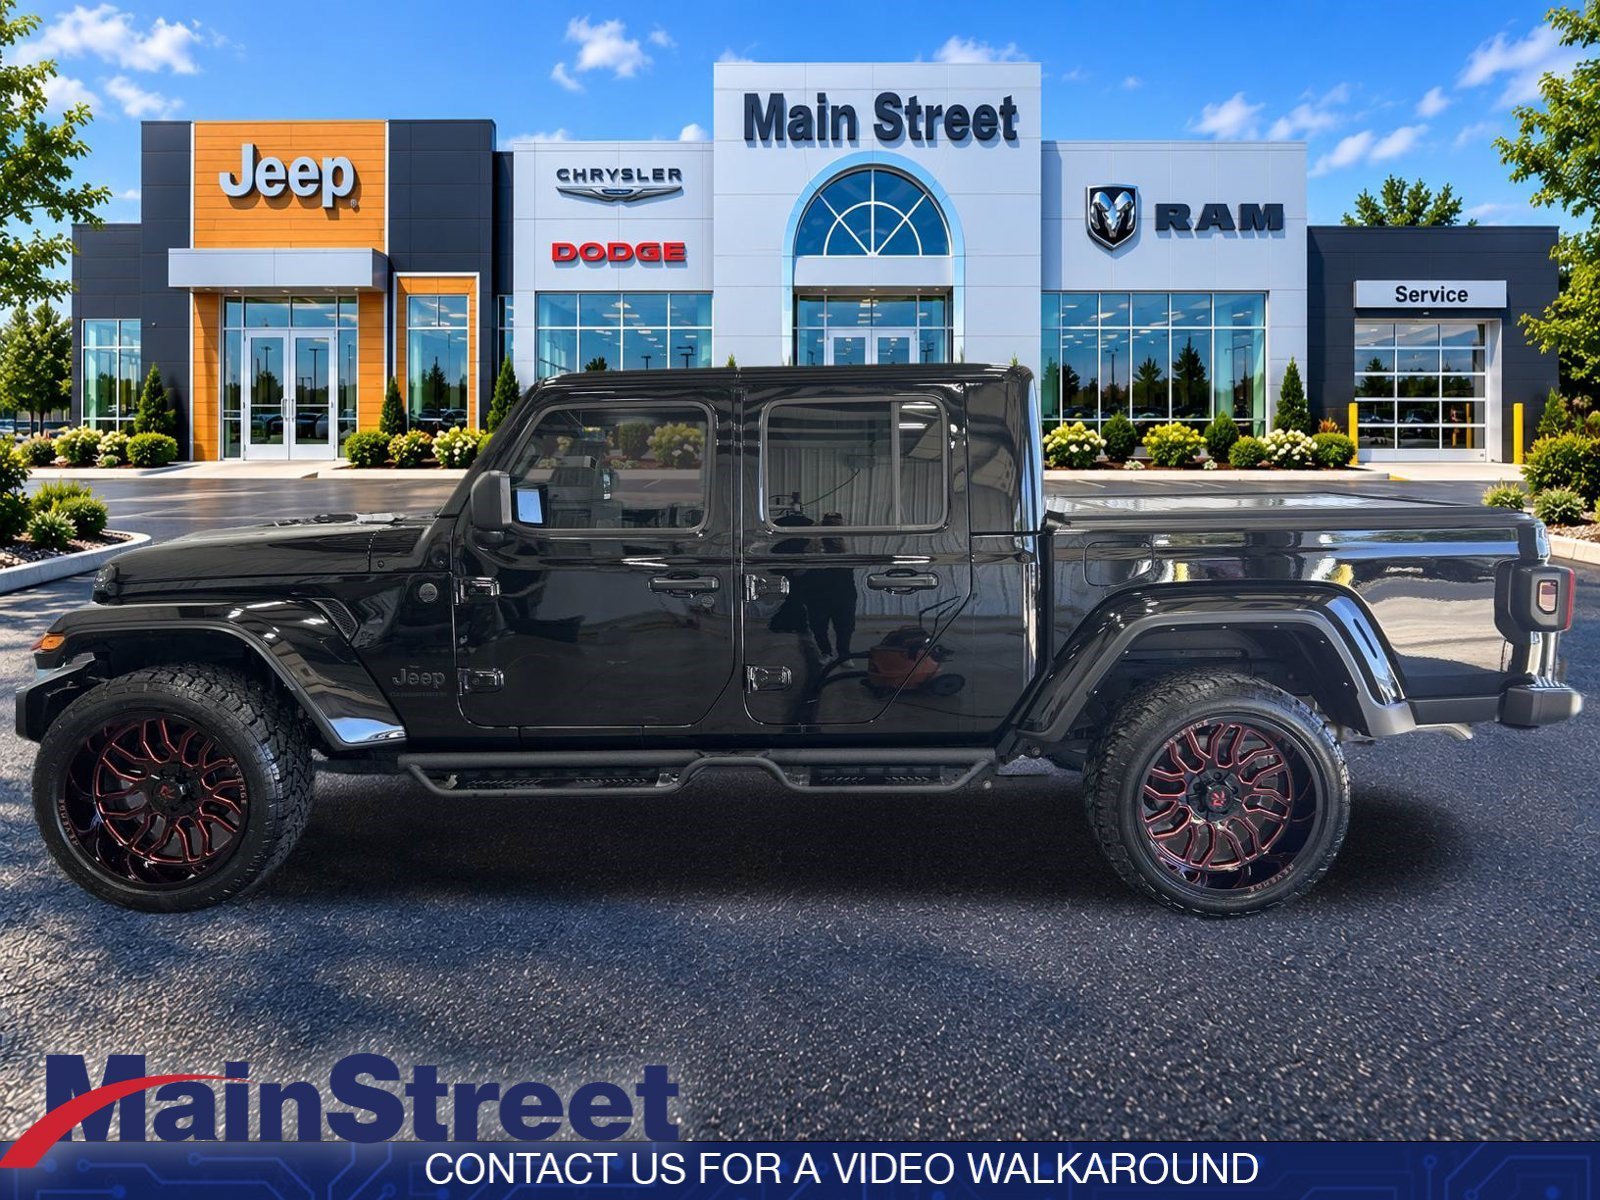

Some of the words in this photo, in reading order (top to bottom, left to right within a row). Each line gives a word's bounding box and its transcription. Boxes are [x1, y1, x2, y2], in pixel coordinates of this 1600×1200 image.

[743, 92, 857, 143] Main
[874, 91, 1018, 143] Street
[218, 143, 355, 209] Jeep
[556, 168, 683, 183] CHRYSLER
[1154, 203, 1284, 232] RAM
[551, 242, 687, 263] DODGE
[1395, 285, 1469, 303] Service
[391, 668, 446, 689] Jeep
